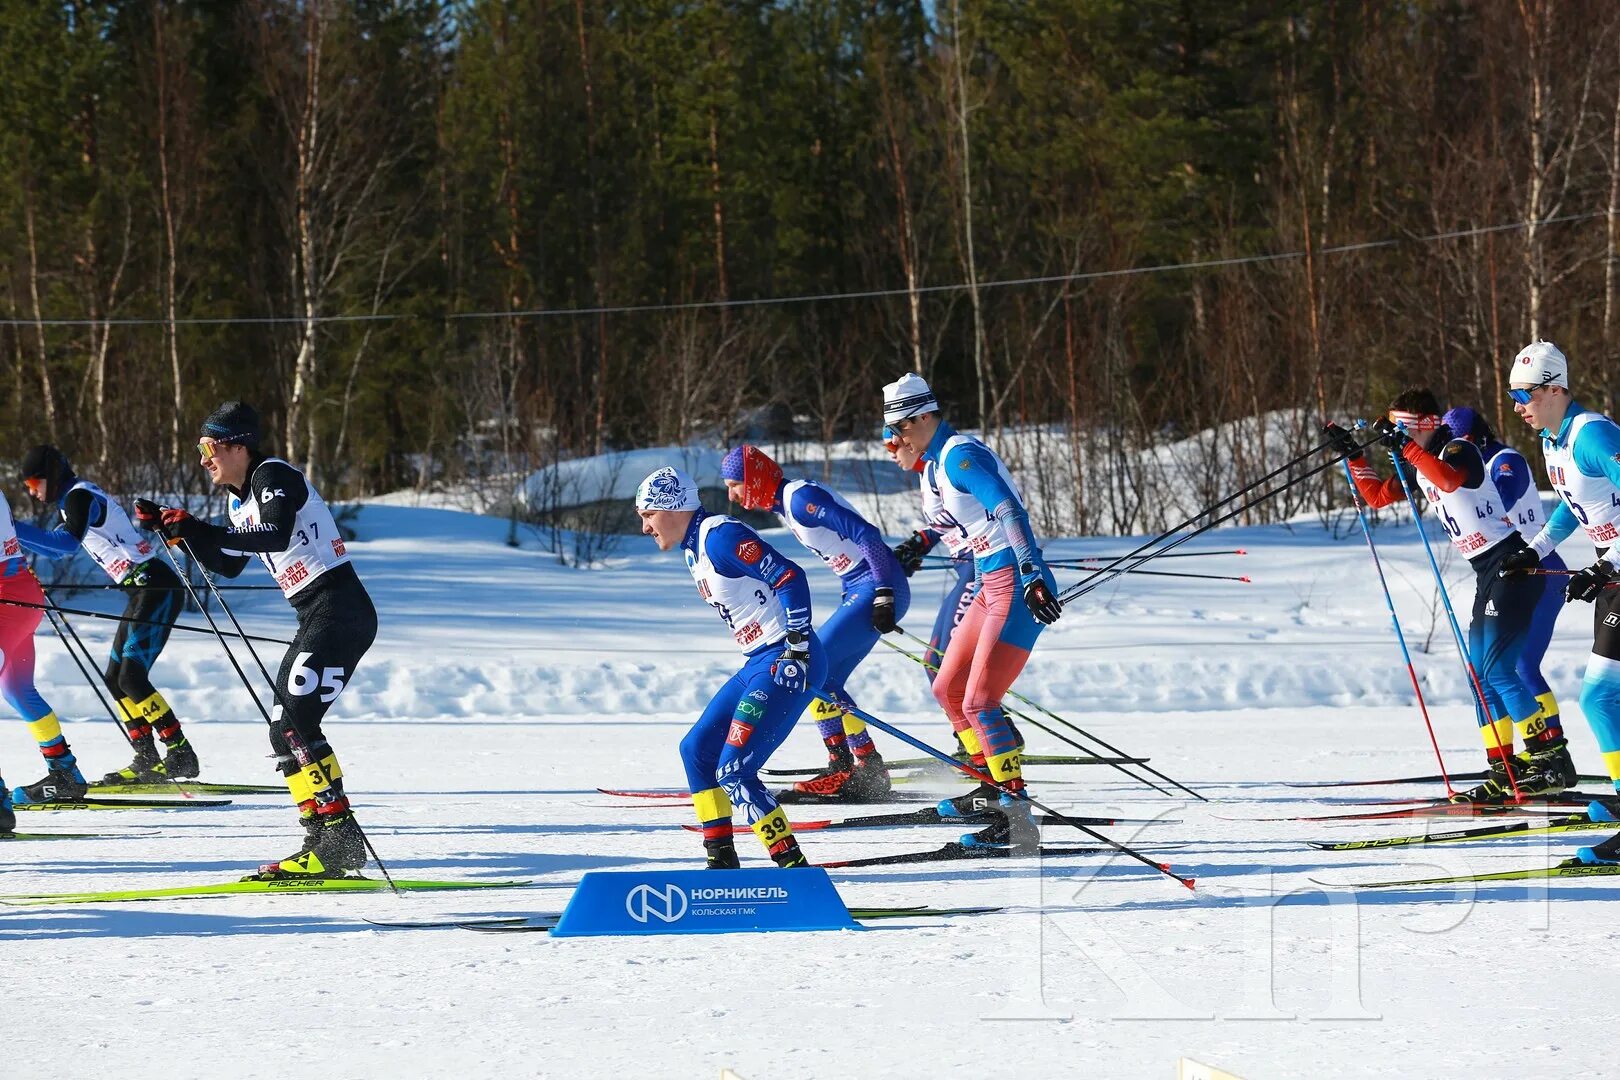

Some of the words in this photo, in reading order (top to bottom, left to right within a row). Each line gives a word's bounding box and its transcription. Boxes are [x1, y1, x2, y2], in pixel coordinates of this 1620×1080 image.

[1475, 500, 1493, 519] 46
[1557, 489, 1589, 525] 5
[1518, 508, 1536, 526] 48
[296, 521, 319, 547] 37
[1469, 535, 1488, 550] 2023
[1599, 527, 1619, 542] 2023
[742, 543, 758, 561] rittis
[285, 565, 294, 574] 50
[287, 567, 310, 587] 2023
[755, 589, 768, 606] 3
[950, 581, 976, 639] СКВА
[745, 625, 764, 645] 2023
[287, 652, 345, 702] 65
[142, 700, 160, 717] 44
[1526, 718, 1545, 735] 46
[1001, 756, 1020, 773] 43
[309, 762, 334, 785] 37
[760, 817, 786, 840] 39
[1333, 835, 1426, 850] FISCHER
[1560, 866, 1618, 876] FISCHER
[267, 880, 325, 888] FISCHER
[691, 887, 789, 900] НОРНИКЕЛЬ
[691, 908, 737, 916] КОЛЬСКАЯ
[738, 907, 756, 915] ГМК
